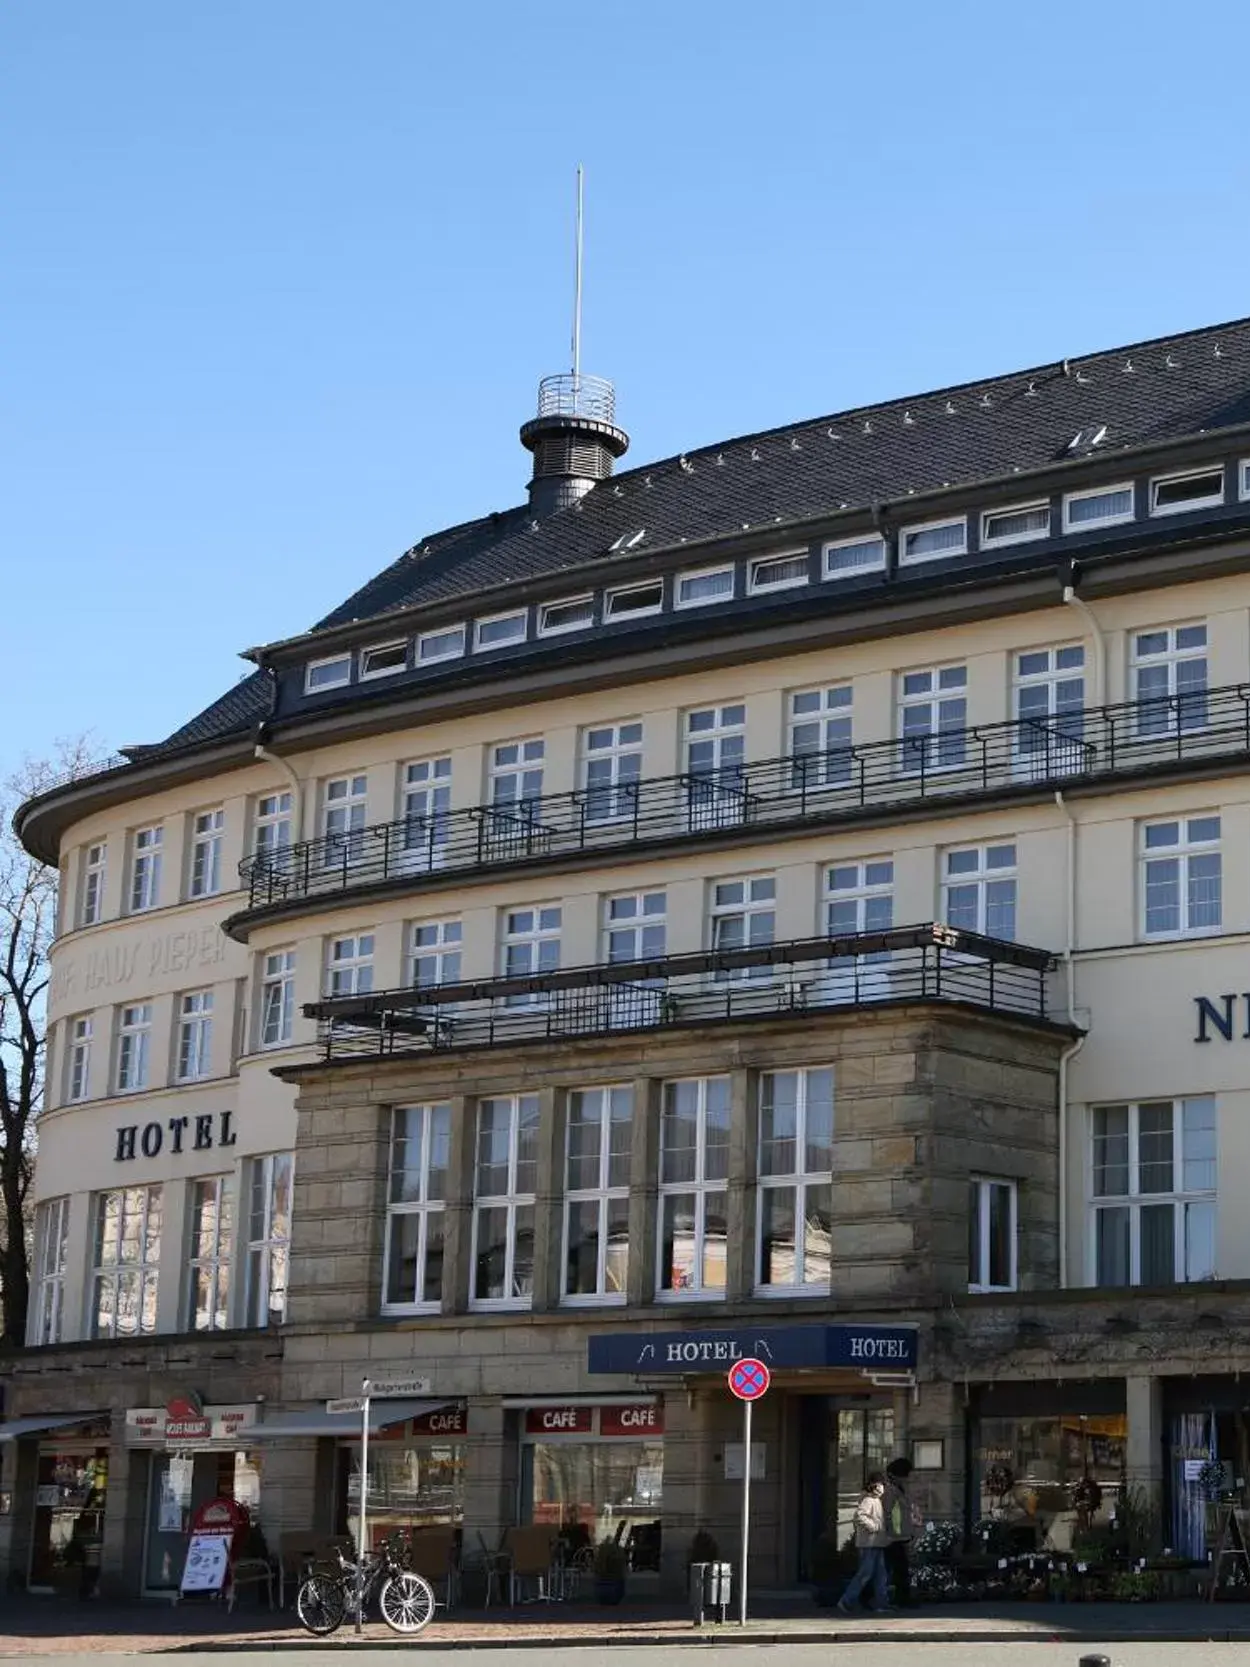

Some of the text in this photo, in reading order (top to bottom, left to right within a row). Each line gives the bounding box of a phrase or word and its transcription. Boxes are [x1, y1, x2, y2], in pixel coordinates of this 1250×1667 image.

[114, 1111, 237, 1162] HOTEL
[666, 1341, 743, 1362] HOTEL
[851, 1337, 909, 1359] HOTEL
[429, 1410, 462, 1431] CAFÉ
[543, 1407, 577, 1428] CAFÉ
